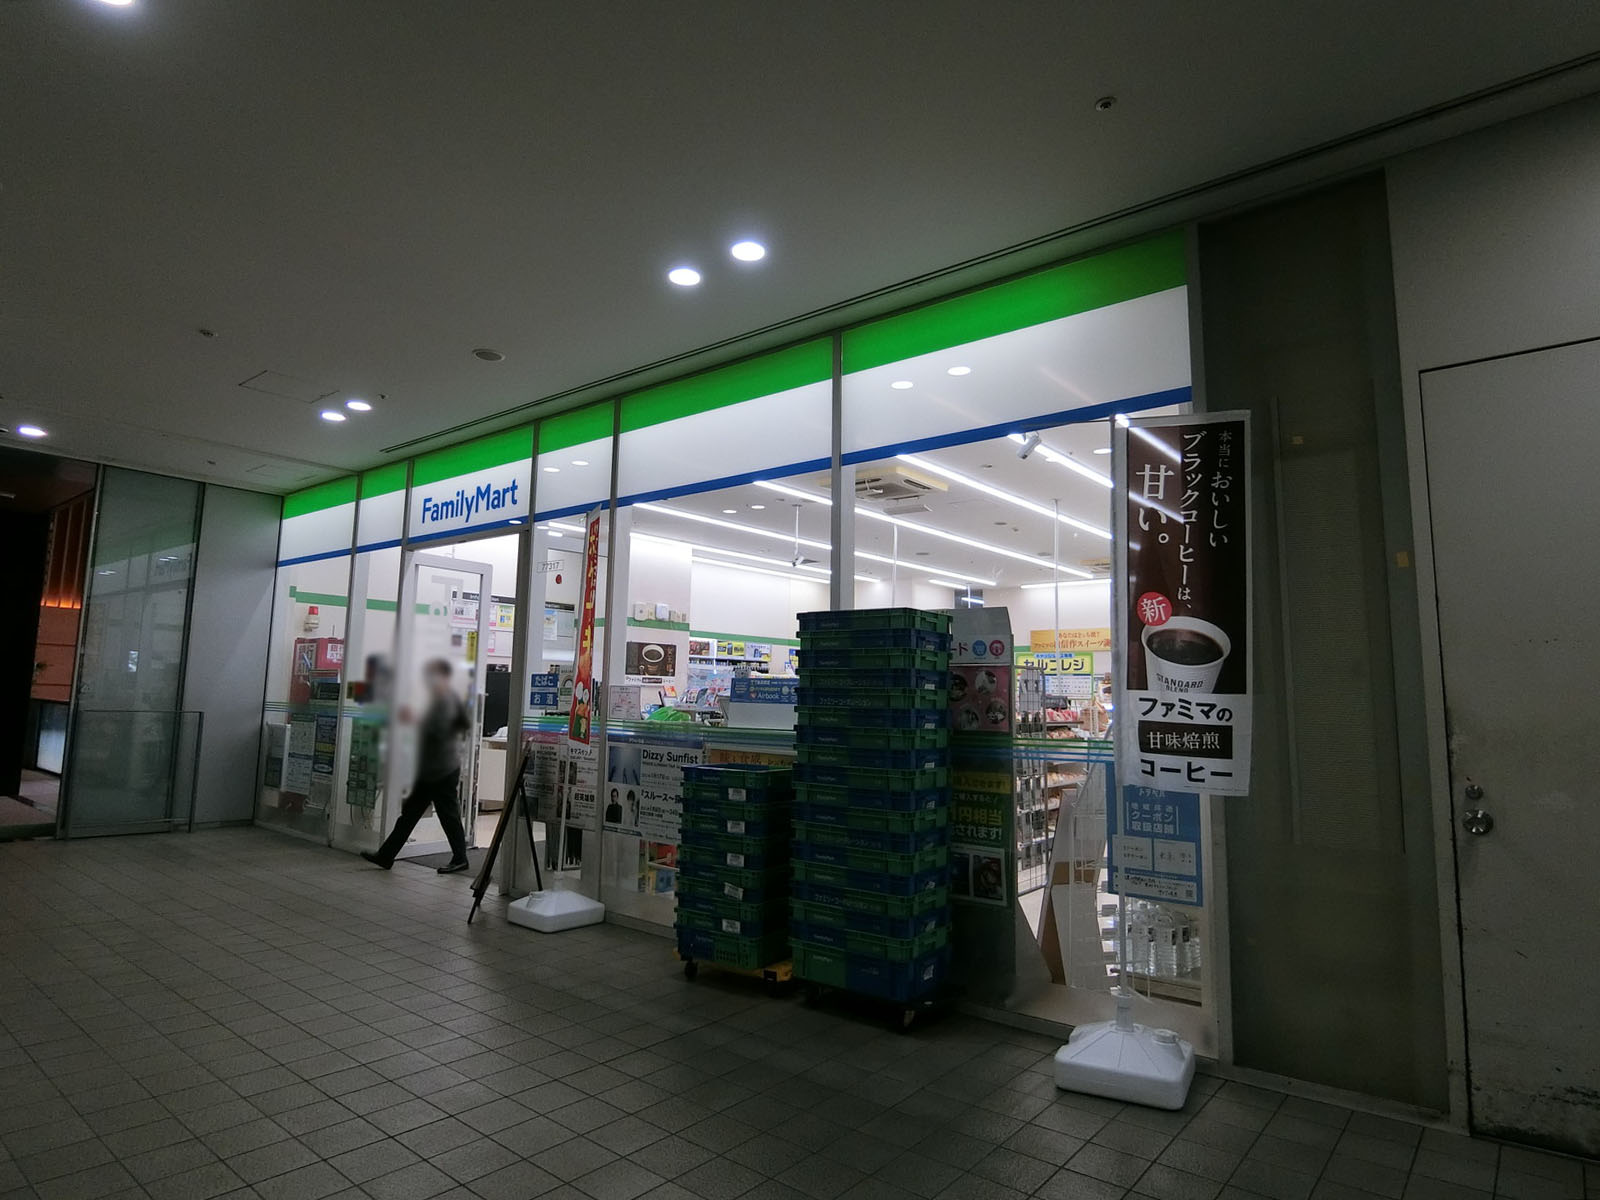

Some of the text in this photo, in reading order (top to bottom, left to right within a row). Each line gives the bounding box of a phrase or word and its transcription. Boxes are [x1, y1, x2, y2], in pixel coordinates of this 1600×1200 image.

[422, 478, 518, 524] FamilyMart
[1209, 430, 1232, 548] 本当においしい
[1135, 464, 1175, 545] 甘い。
[1177, 430, 1208, 609] ブラックコーヒーは、
[1141, 596, 1167, 624] 新
[1156, 673, 1203, 688] STANDARD
[1139, 696, 1233, 722] ファミマの
[1146, 731, 1221, 749] 甘味焙煎
[642, 749, 698, 764] Dizzy Sunfist
[1141, 759, 1233, 783] コーヒー
